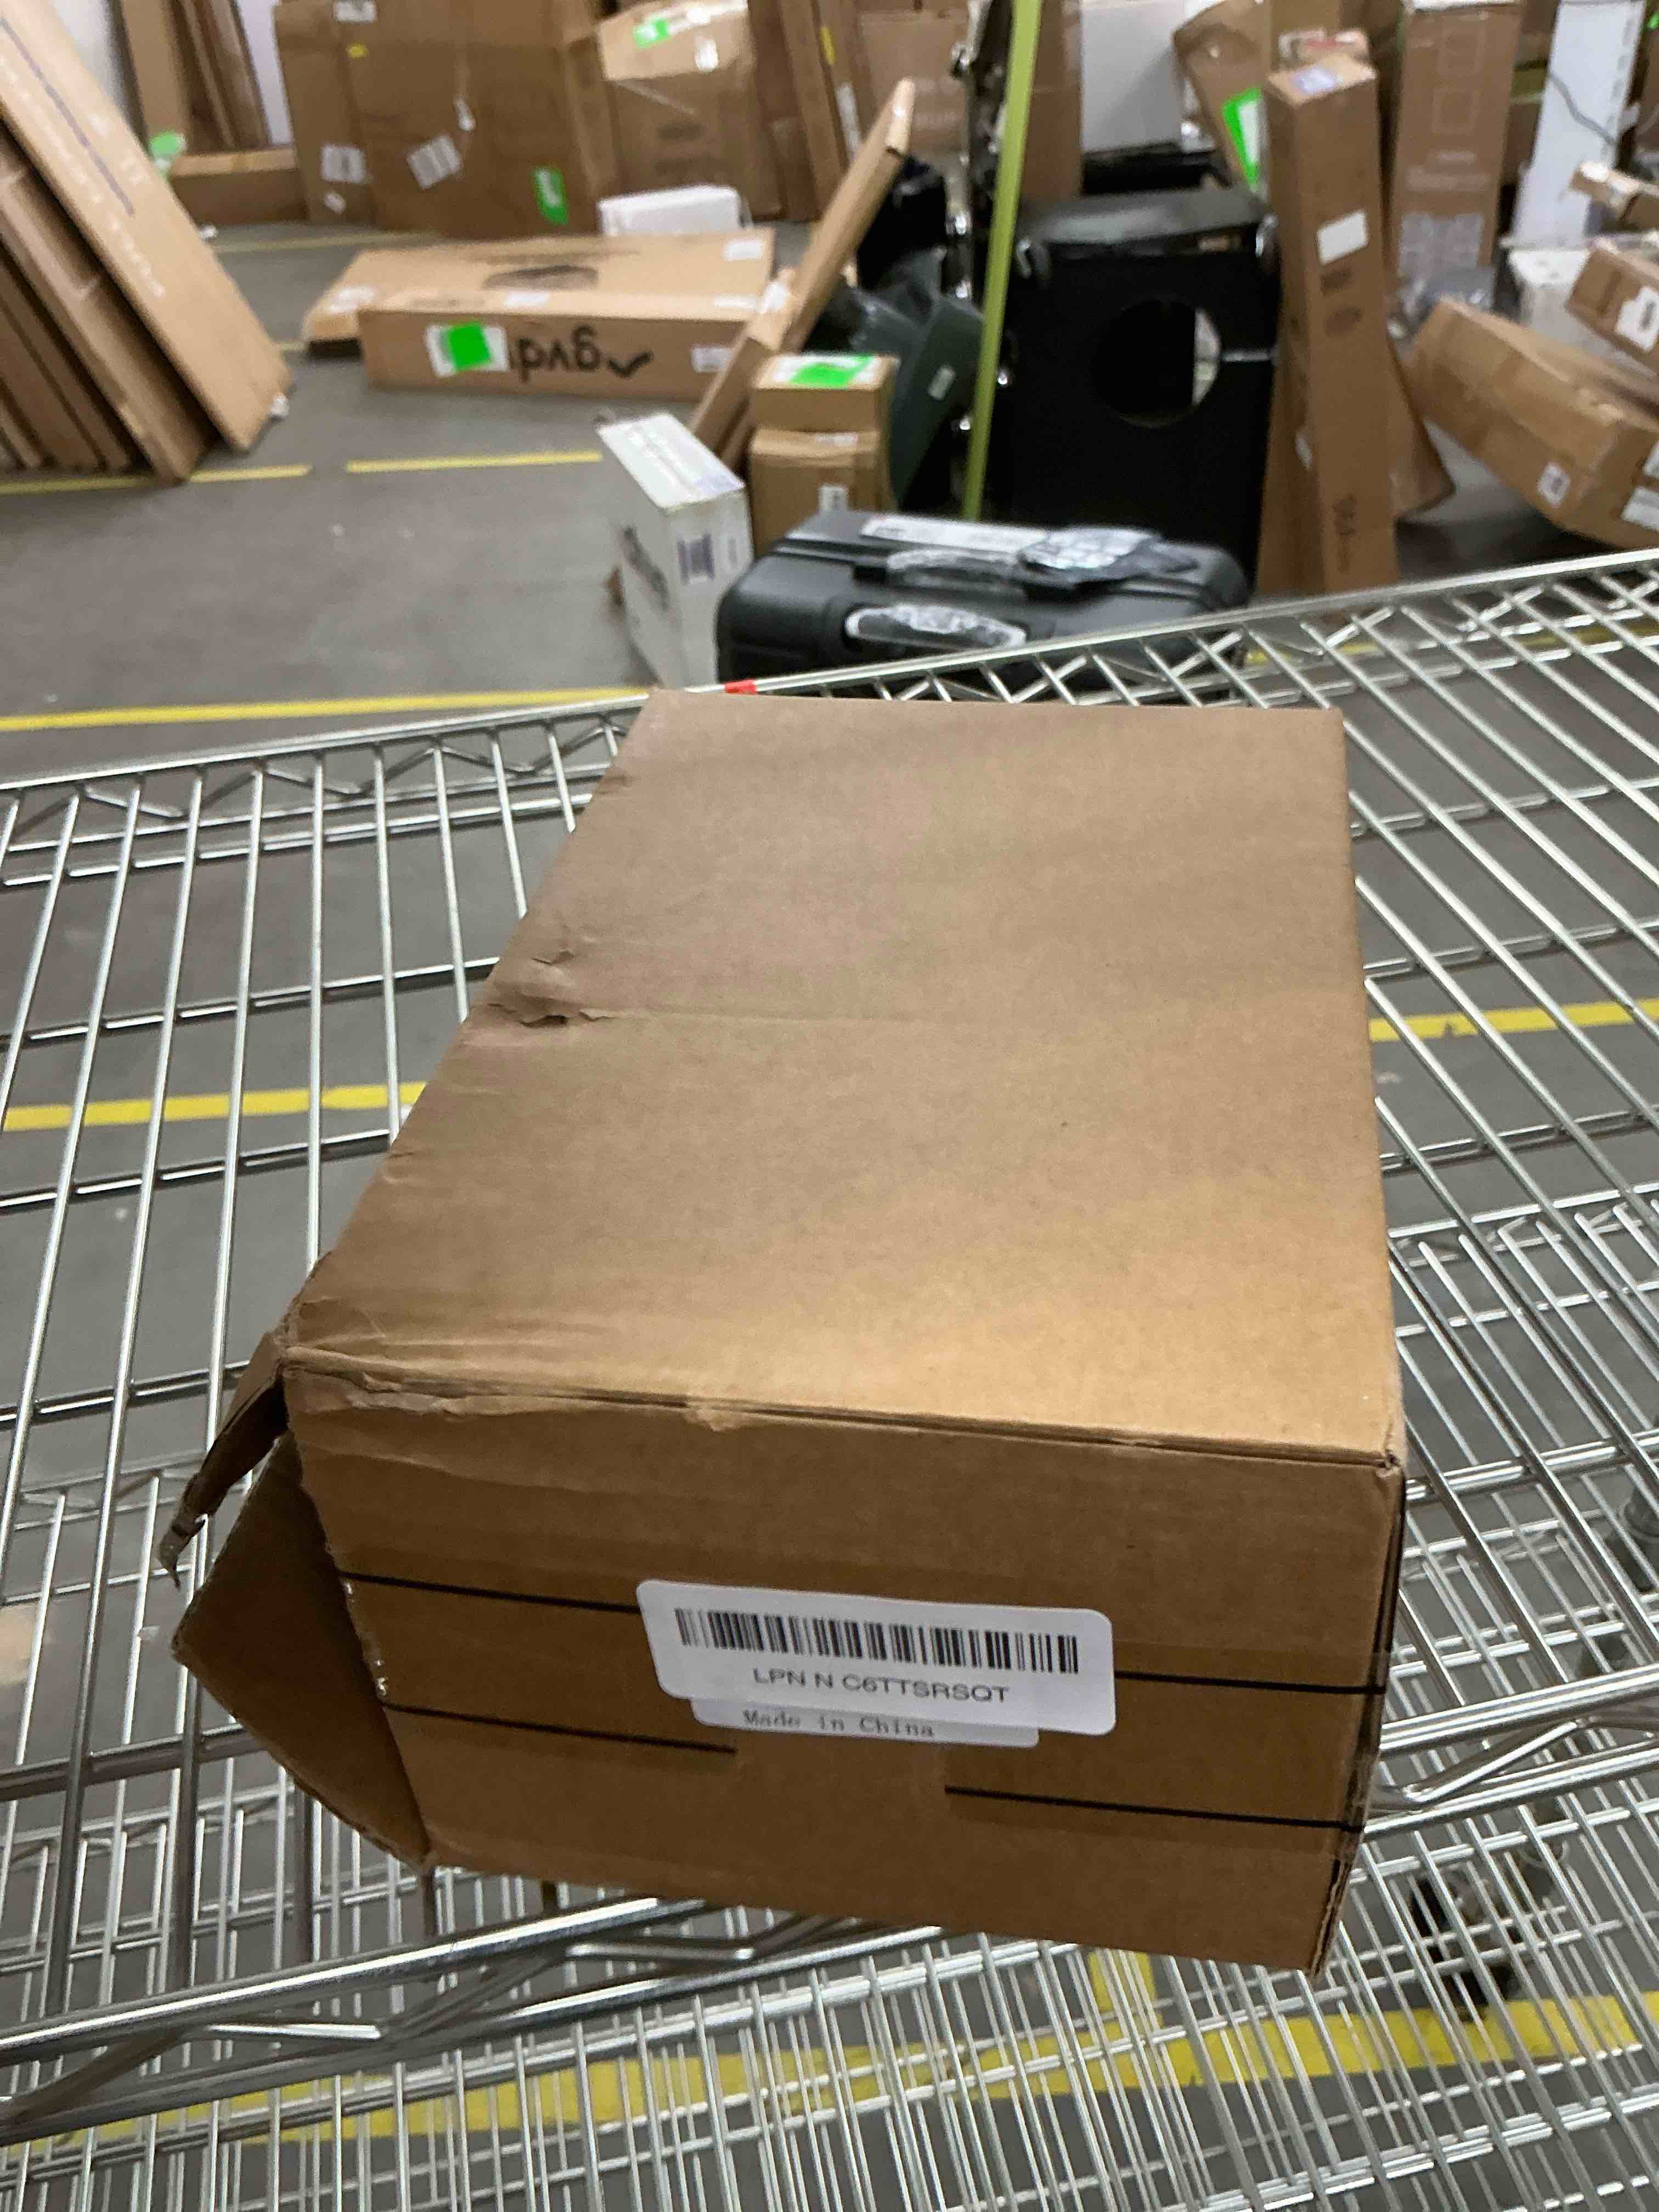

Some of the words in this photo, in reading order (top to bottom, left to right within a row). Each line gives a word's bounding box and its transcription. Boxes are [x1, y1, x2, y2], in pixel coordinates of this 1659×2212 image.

[753, 1667, 806, 1686] LPN
[814, 1671, 833, 1689] N
[743, 1709, 802, 1728] Made
[819, 1715, 845, 1731] in
[859, 1716, 934, 1737] China
